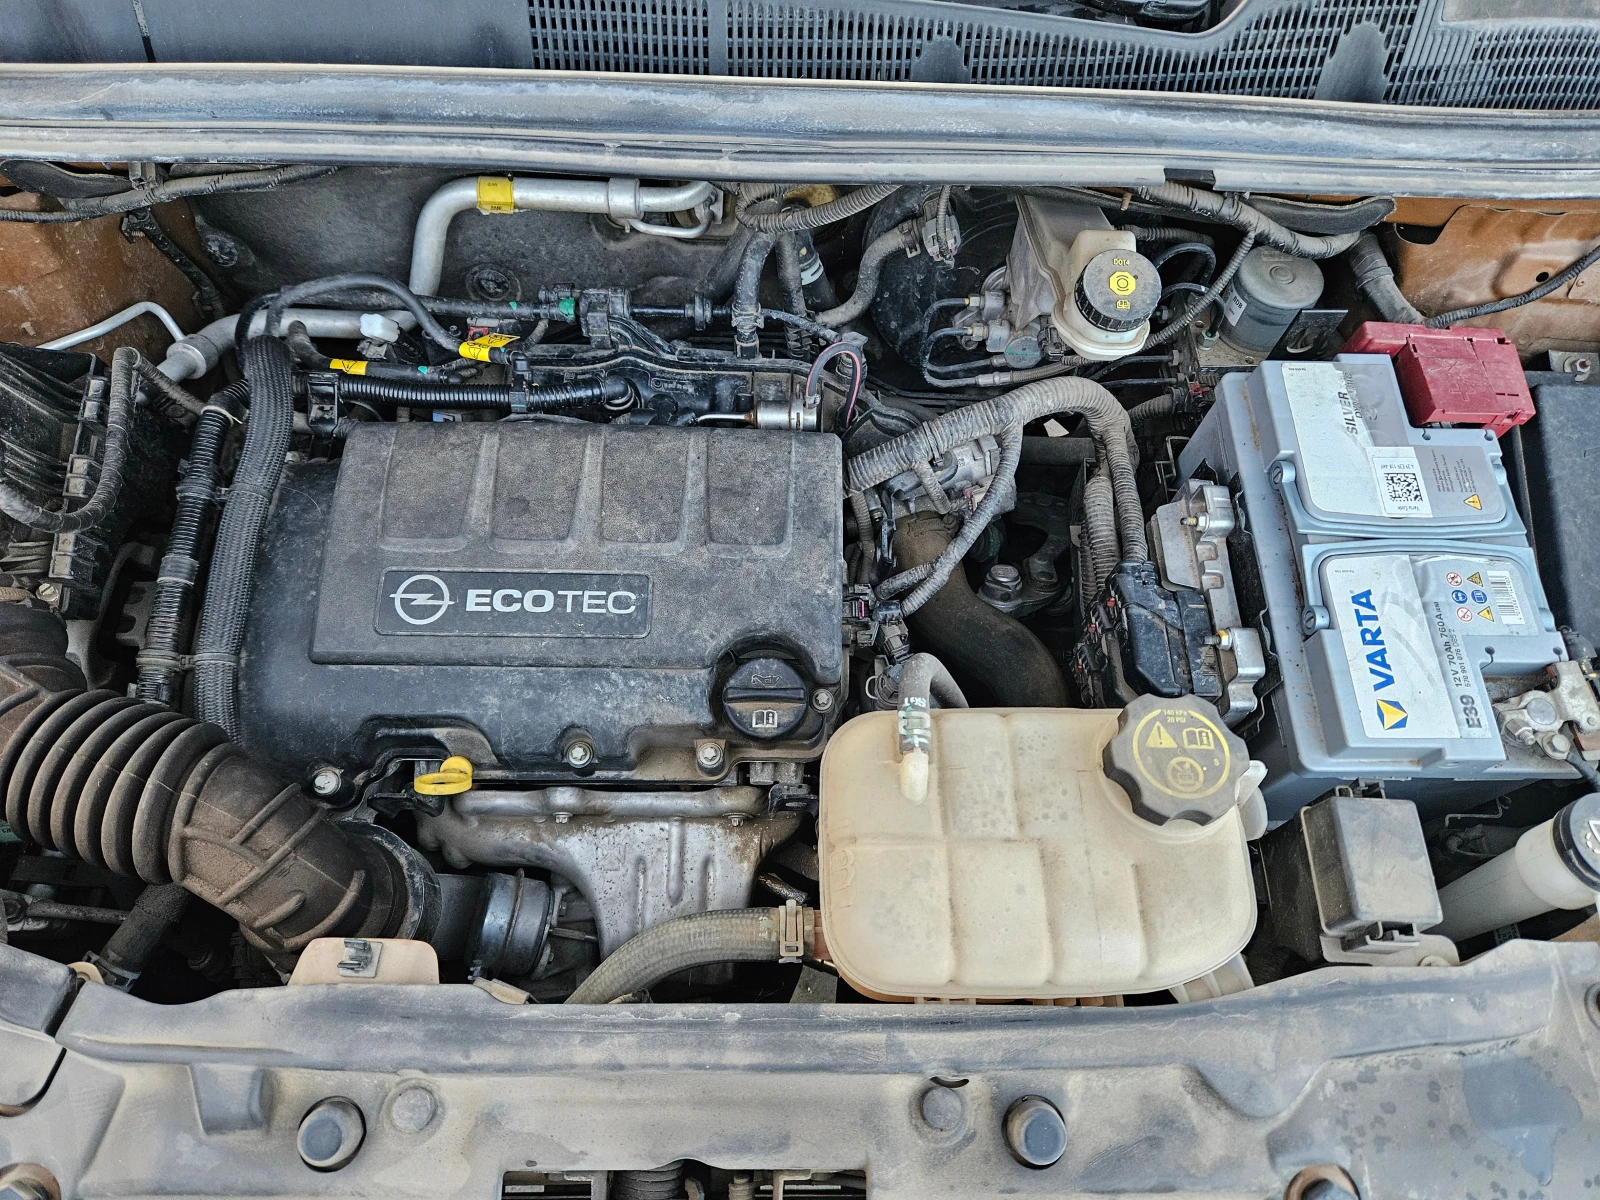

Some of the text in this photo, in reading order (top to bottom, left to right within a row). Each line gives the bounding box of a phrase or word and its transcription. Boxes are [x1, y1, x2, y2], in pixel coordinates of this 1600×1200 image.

[1113, 258, 1130, 266] DOT4
[1345, 372, 1363, 419] DYNIC
[1338, 391, 1358, 435] SILVER
[466, 588, 637, 614] ECOTEC
[1351, 588, 1396, 692] VARTA
[1443, 641, 1456, 666] 70Ah
[1459, 662, 1467, 674] 901
[1460, 694, 1483, 729] E39
